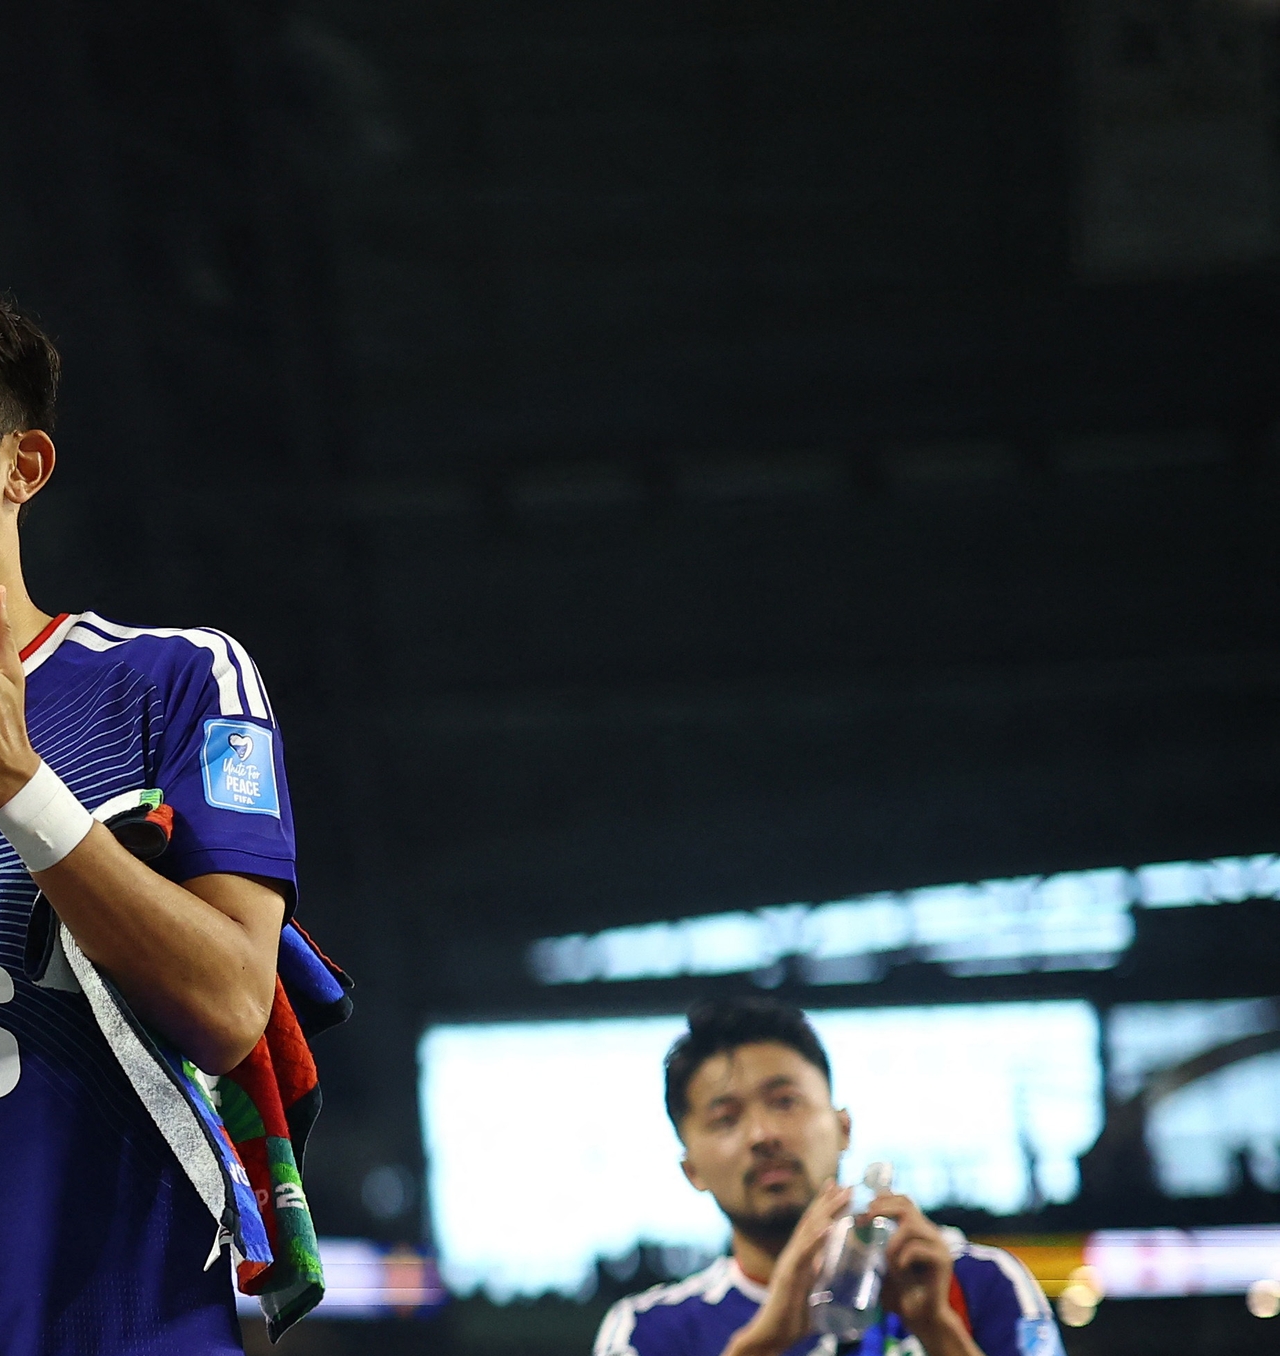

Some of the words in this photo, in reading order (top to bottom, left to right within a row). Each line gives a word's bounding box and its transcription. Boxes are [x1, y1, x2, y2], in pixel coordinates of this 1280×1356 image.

[223, 758, 246, 776] Unite
[246, 765, 261, 780] For
[226, 775, 261, 797] PEACE
[234, 793, 255, 805] FIFA
